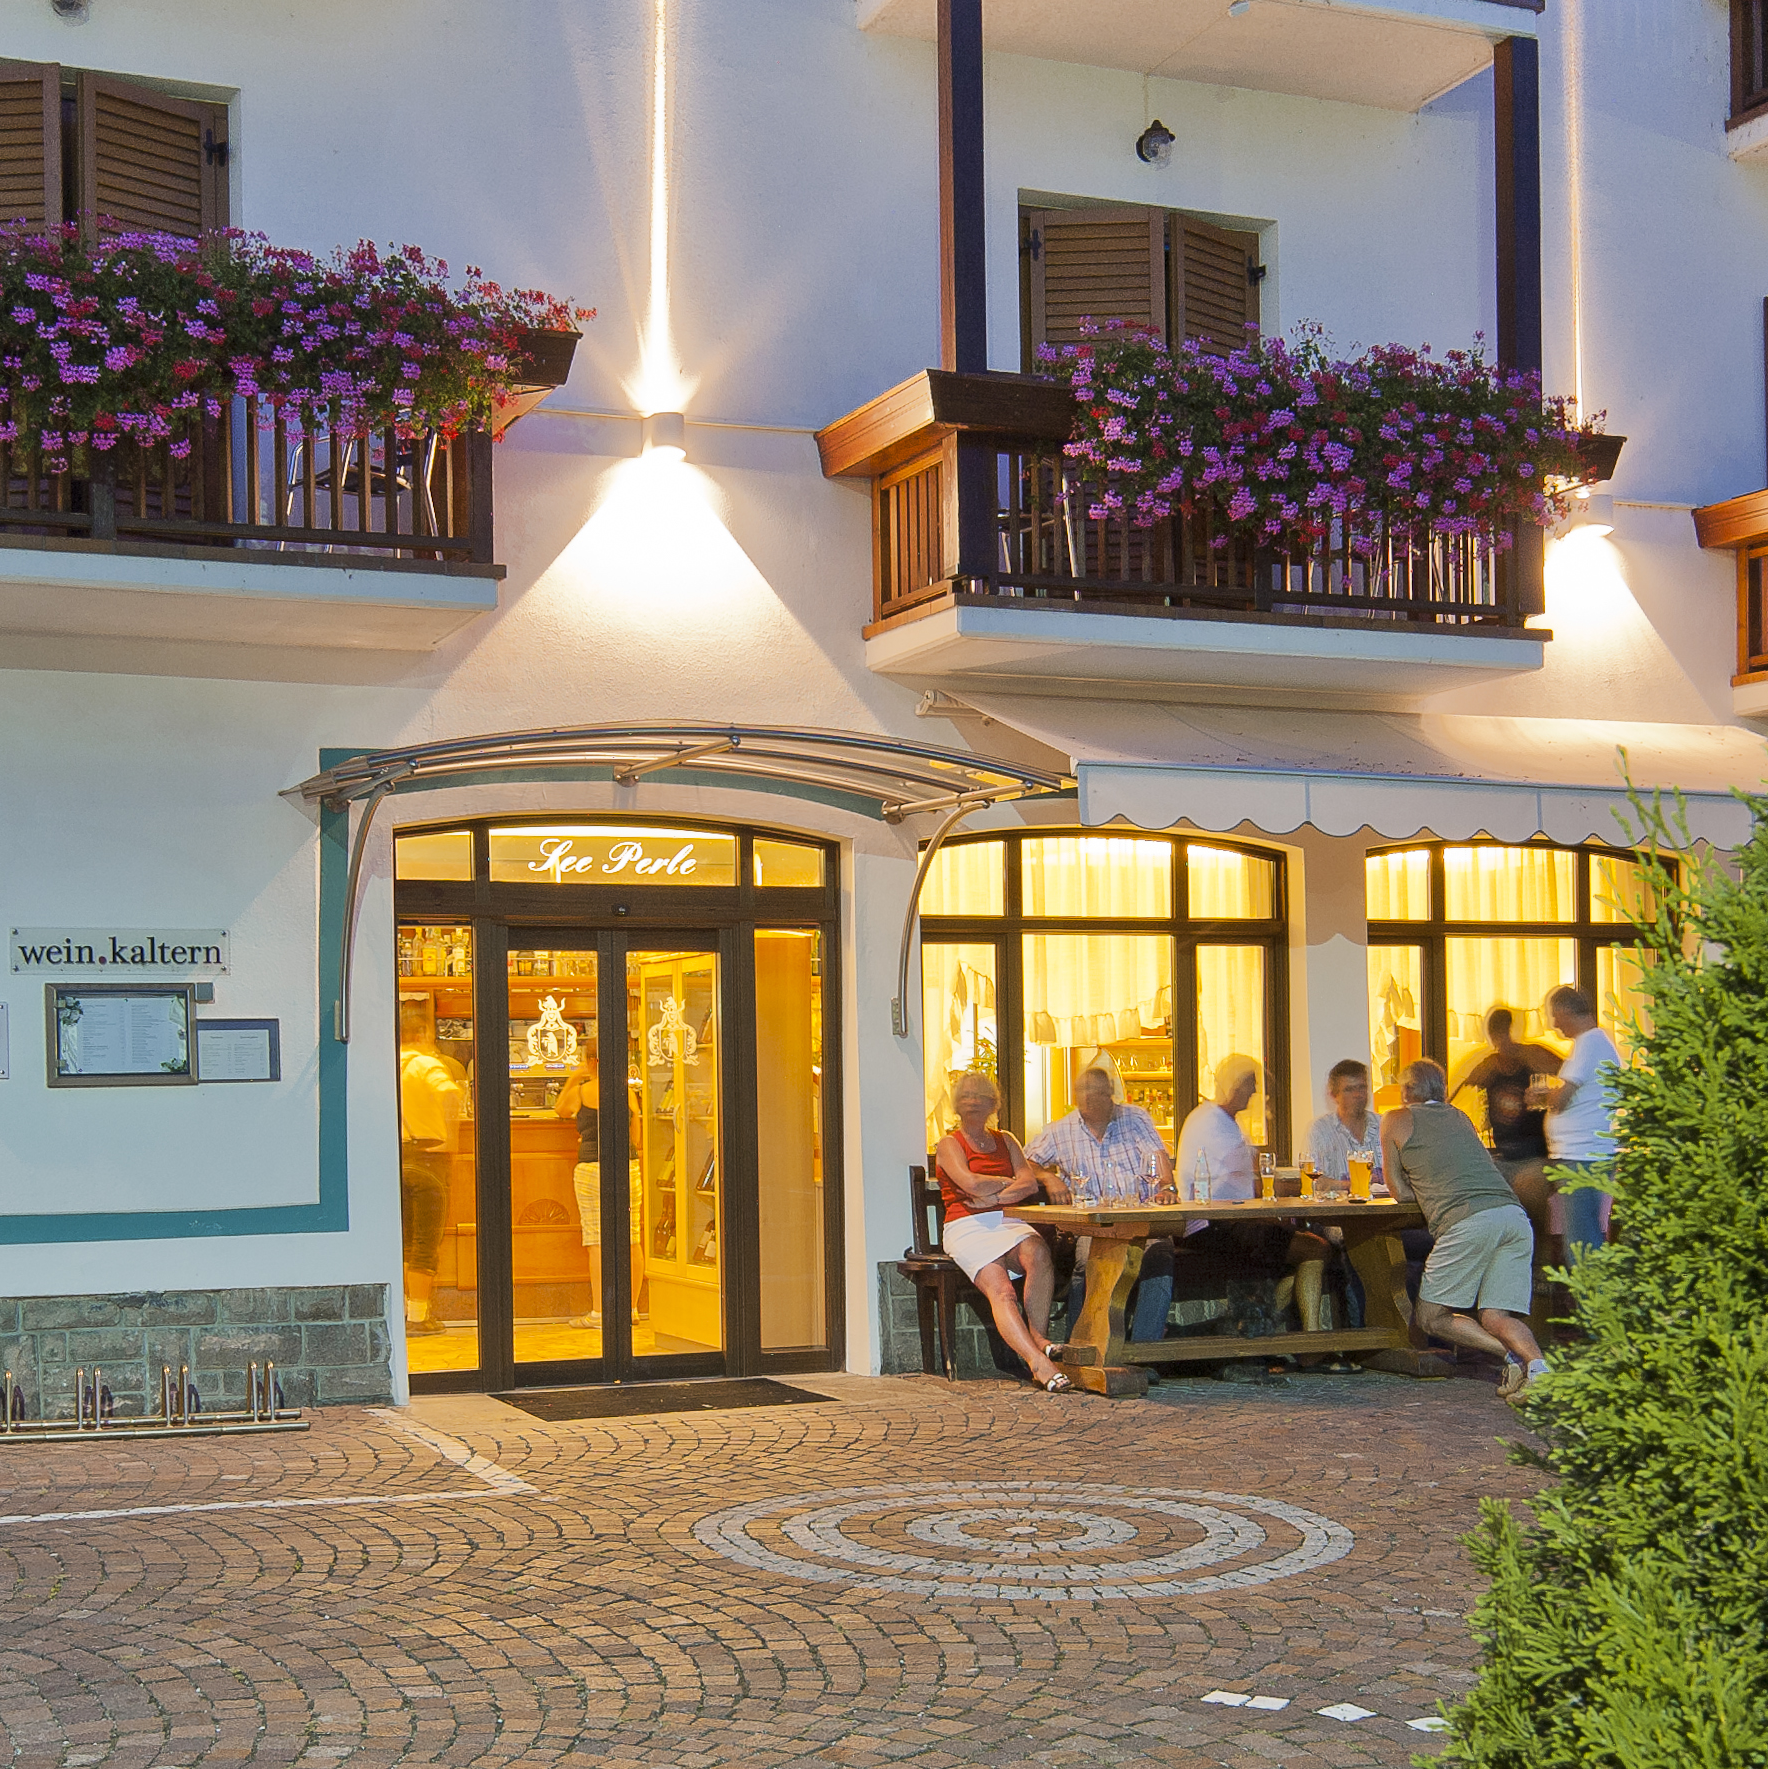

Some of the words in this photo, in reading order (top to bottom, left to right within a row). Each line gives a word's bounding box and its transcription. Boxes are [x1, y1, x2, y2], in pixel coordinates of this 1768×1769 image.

[528, 838, 593, 872] See
[602, 841, 697, 875] Perle
[18, 936, 222, 965] wein.kaltern
